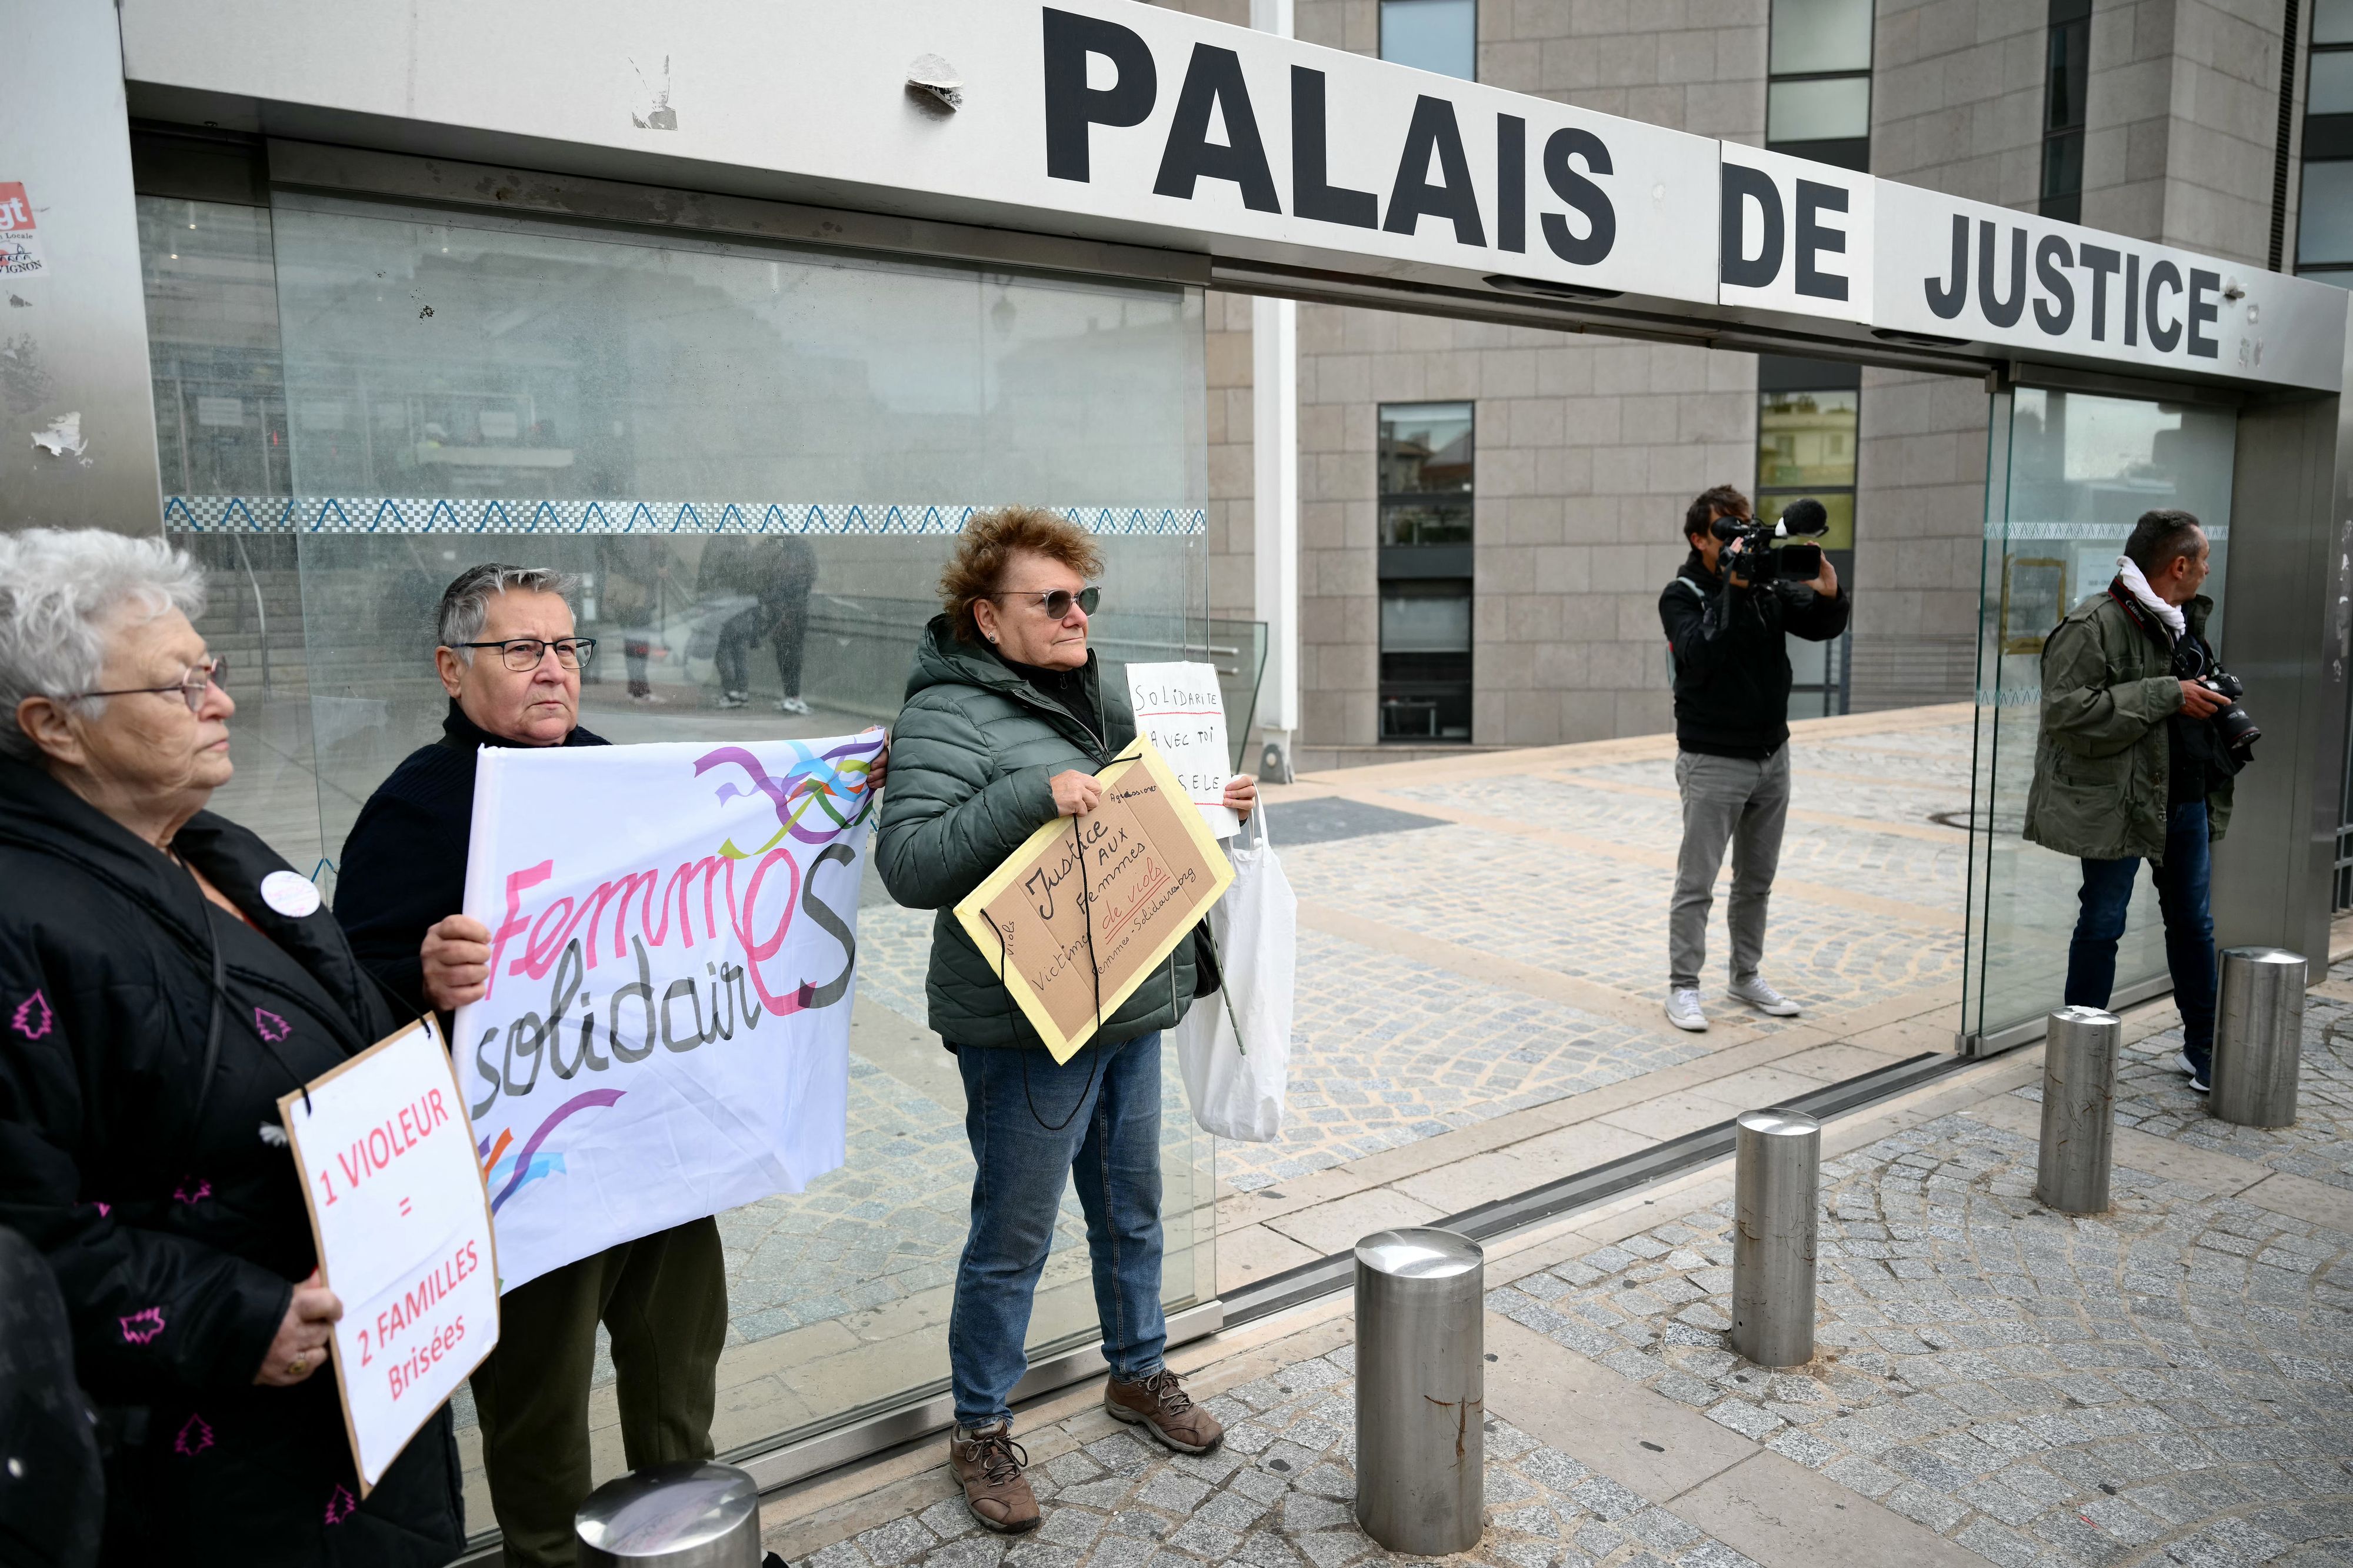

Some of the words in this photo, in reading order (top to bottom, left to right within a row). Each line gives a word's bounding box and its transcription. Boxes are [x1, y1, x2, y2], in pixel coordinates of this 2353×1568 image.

[1042, 6, 1617, 266] PALAIS
[1721, 161, 1849, 302] DE
[1924, 213, 2221, 359] JUSTICE
[2125, 600, 2145, 622] Canon
[1025, 822, 1108, 920] Justice
[1032, 932, 1091, 991] Victime
[1102, 900, 1122, 929] de
[1128, 857, 1162, 903] viols
[319, 1169, 338, 1207] 1
[337, 1087, 449, 1188] VIOLEUR
[357, 1329, 372, 1367] 2
[376, 1239, 478, 1348] FAMILLES
[388, 1315, 466, 1402] Brisées
